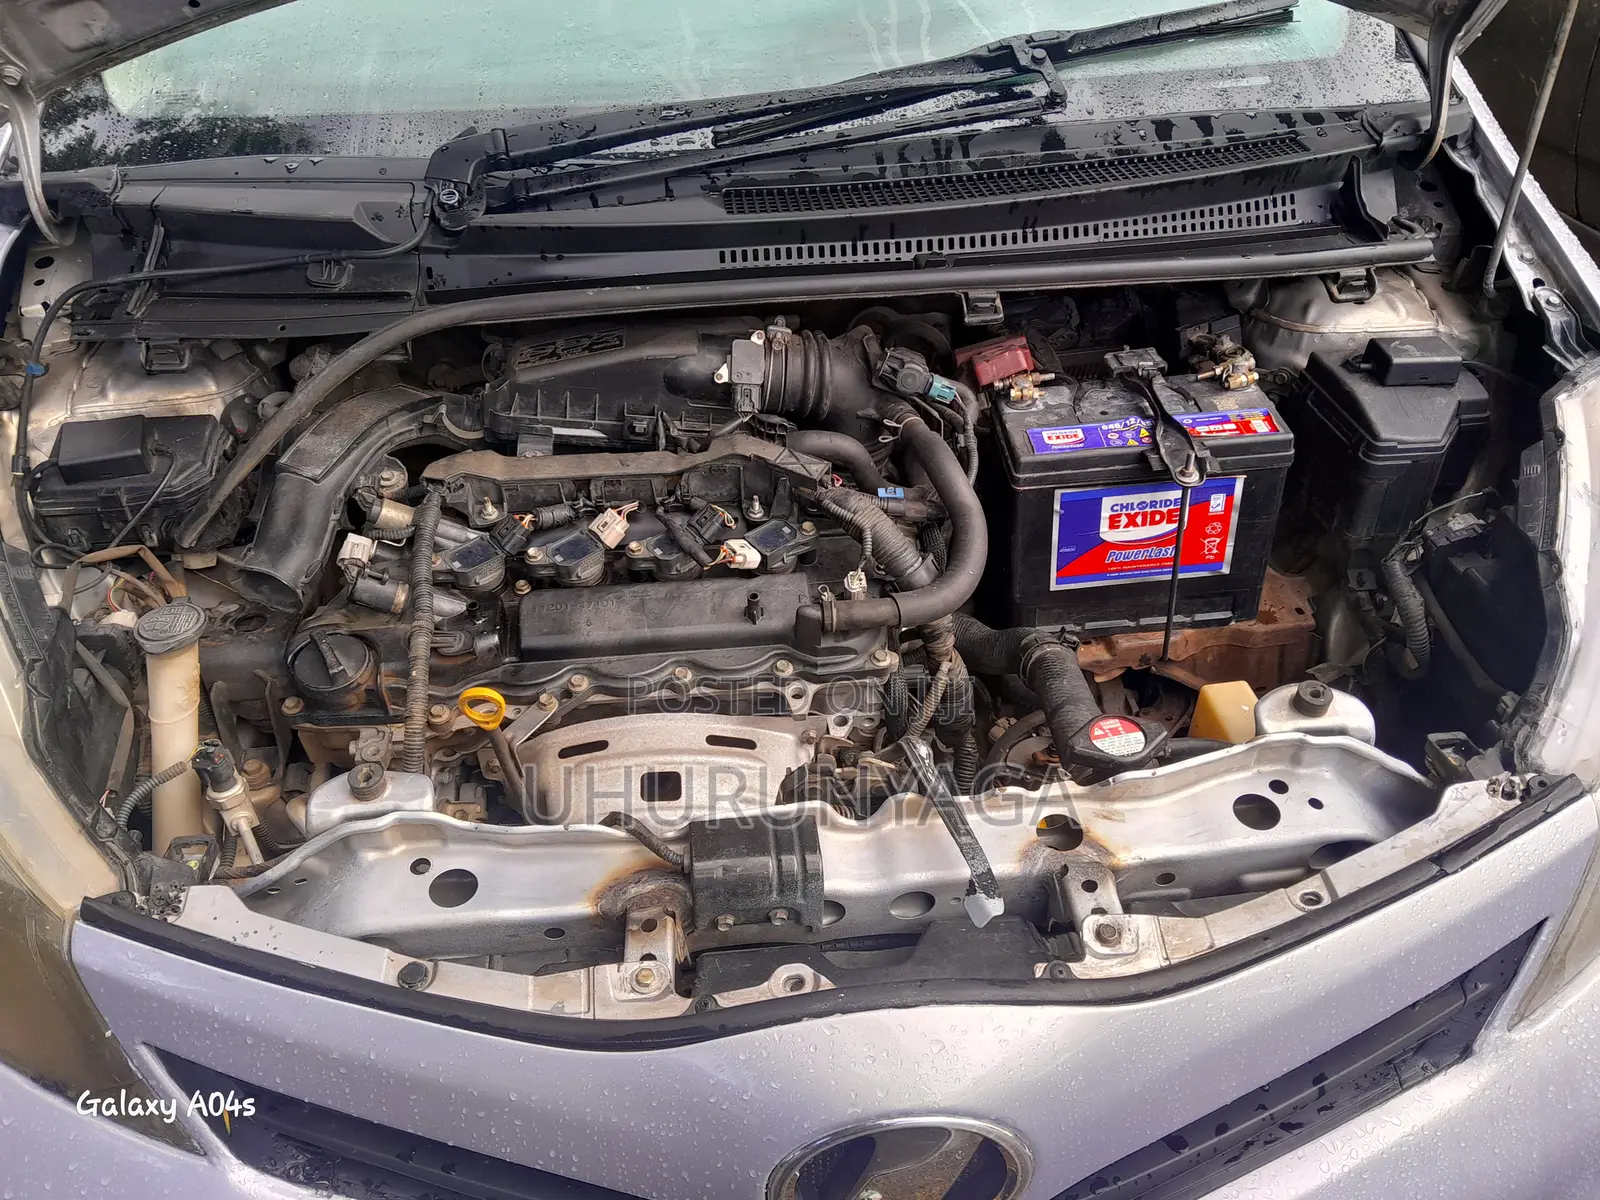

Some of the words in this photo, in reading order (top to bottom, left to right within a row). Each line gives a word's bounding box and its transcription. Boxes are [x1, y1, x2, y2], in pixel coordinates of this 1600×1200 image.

[1110, 498, 1182, 512] CHLORIDE
[1108, 507, 1181, 530] EXIDE
[1105, 545, 1177, 563] PowerLast
